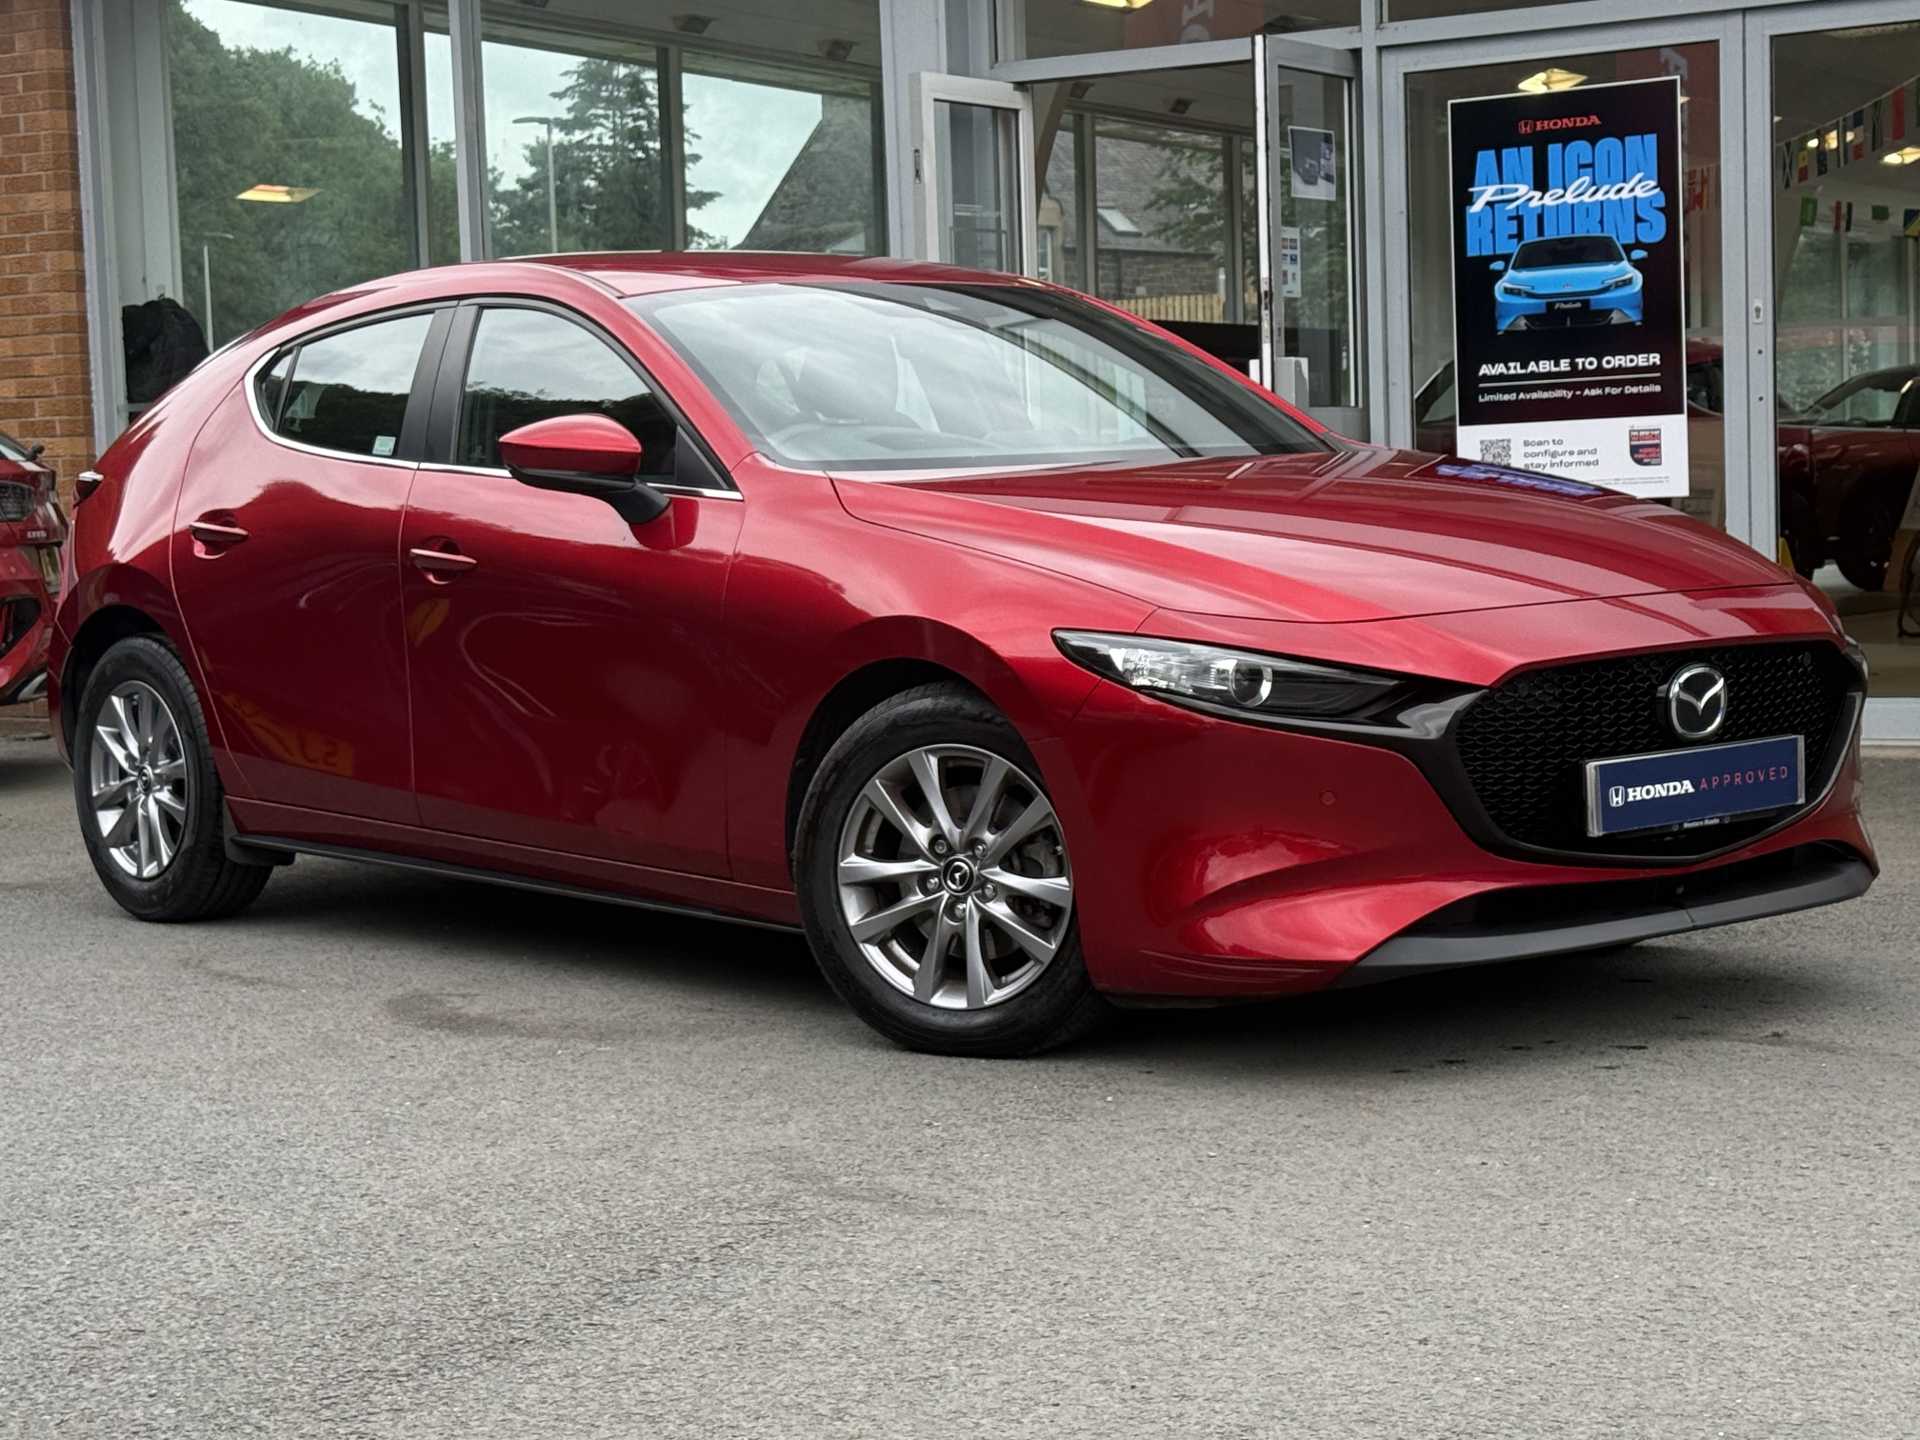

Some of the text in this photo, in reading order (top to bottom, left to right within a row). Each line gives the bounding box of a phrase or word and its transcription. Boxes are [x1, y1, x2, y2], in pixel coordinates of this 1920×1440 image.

[1536, 115, 1601, 130] HONDA
[1473, 133, 1657, 203] AN ICON
[1468, 172, 1661, 213] Prelude
[1466, 191, 1666, 257] RETURNS
[1478, 353, 1661, 376] AVAILABLE TO ORDER
[1478, 392, 1517, 403] Limited
[1518, 388, 1573, 400] Availability
[1583, 386, 1603, 396] Ask
[1604, 385, 1622, 395] For
[1624, 383, 1661, 394] Details
[1552, 438, 1564, 446] to
[1523, 447, 1598, 459] configure and
[1549, 458, 1599, 468] informed
[1626, 766, 1788, 802] HONDA APPROVED
